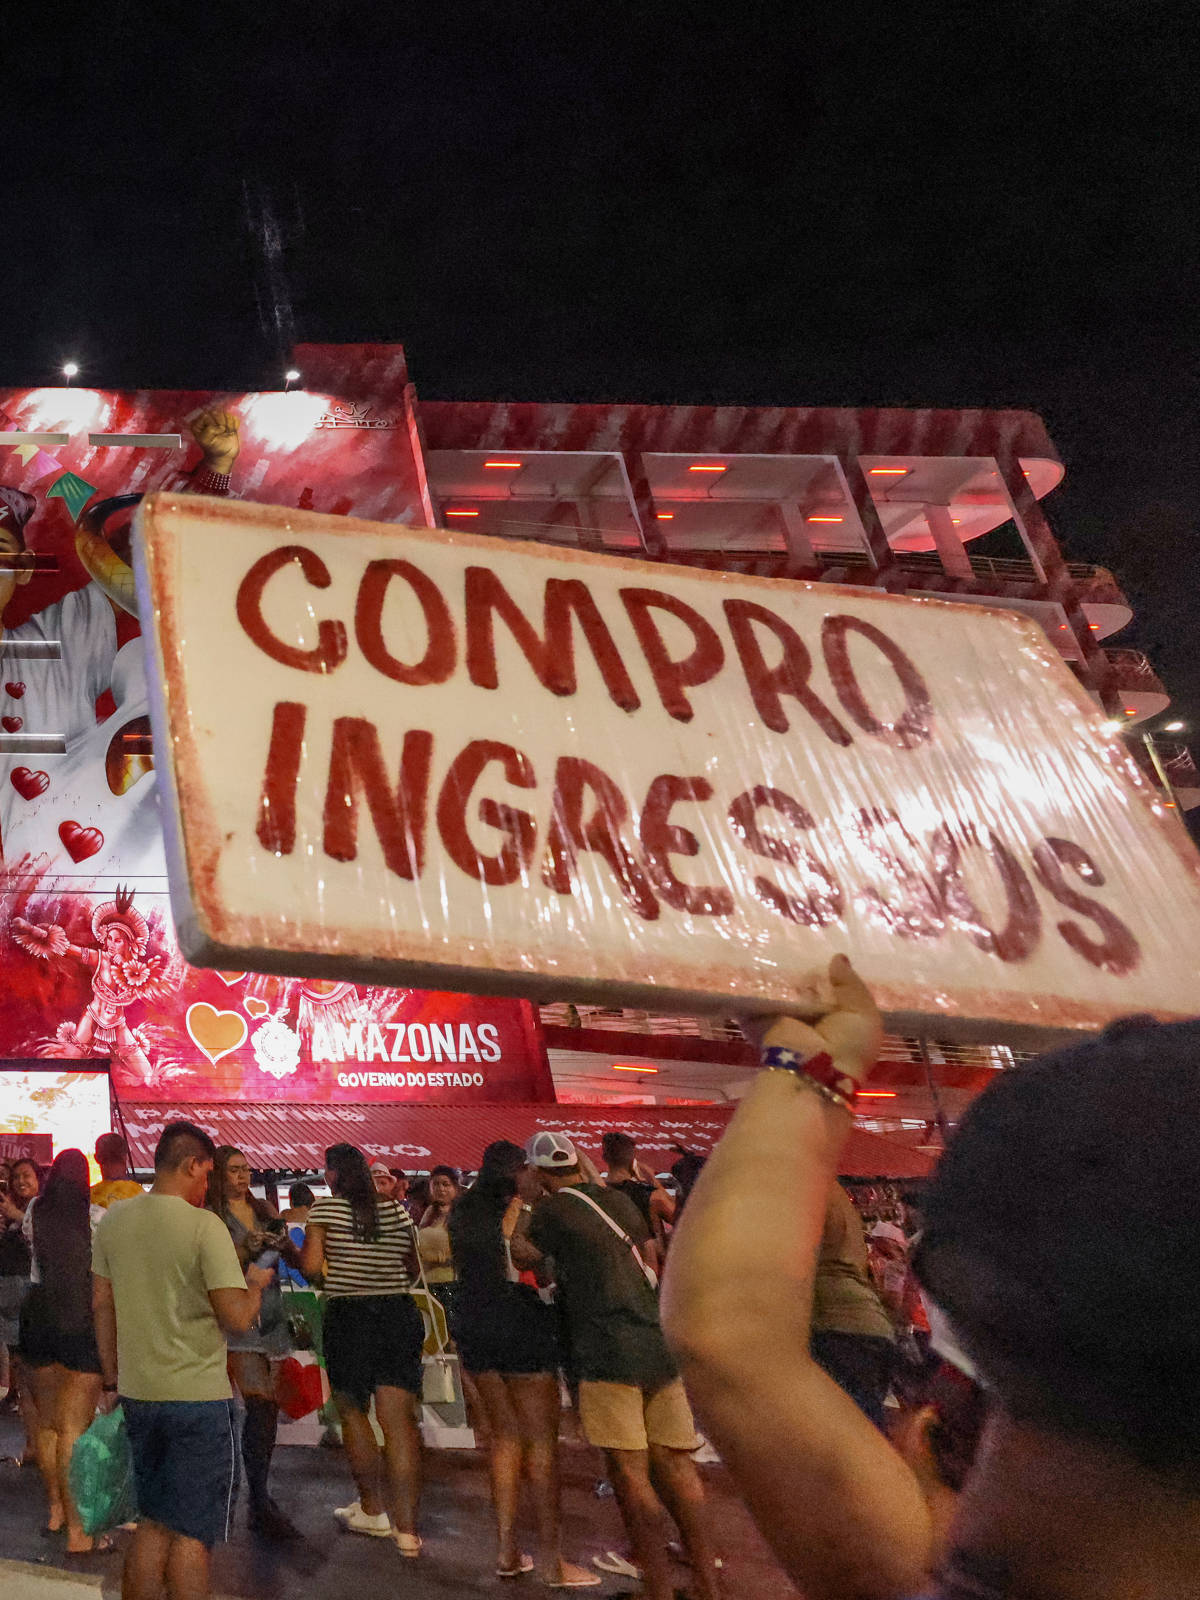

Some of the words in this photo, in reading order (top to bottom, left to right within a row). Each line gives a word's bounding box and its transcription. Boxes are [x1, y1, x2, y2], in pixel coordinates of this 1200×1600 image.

[236, 545, 933, 751] COMPRO
[255, 701, 1142, 977] INGRESSOS
[311, 1023, 502, 1063] AMAZONAS
[337, 1072, 406, 1087] GOVERNO
[407, 1072, 426, 1087] DO
[428, 1072, 484, 1087] ESTADO
[134, 1108, 366, 1123] PARINTINS
